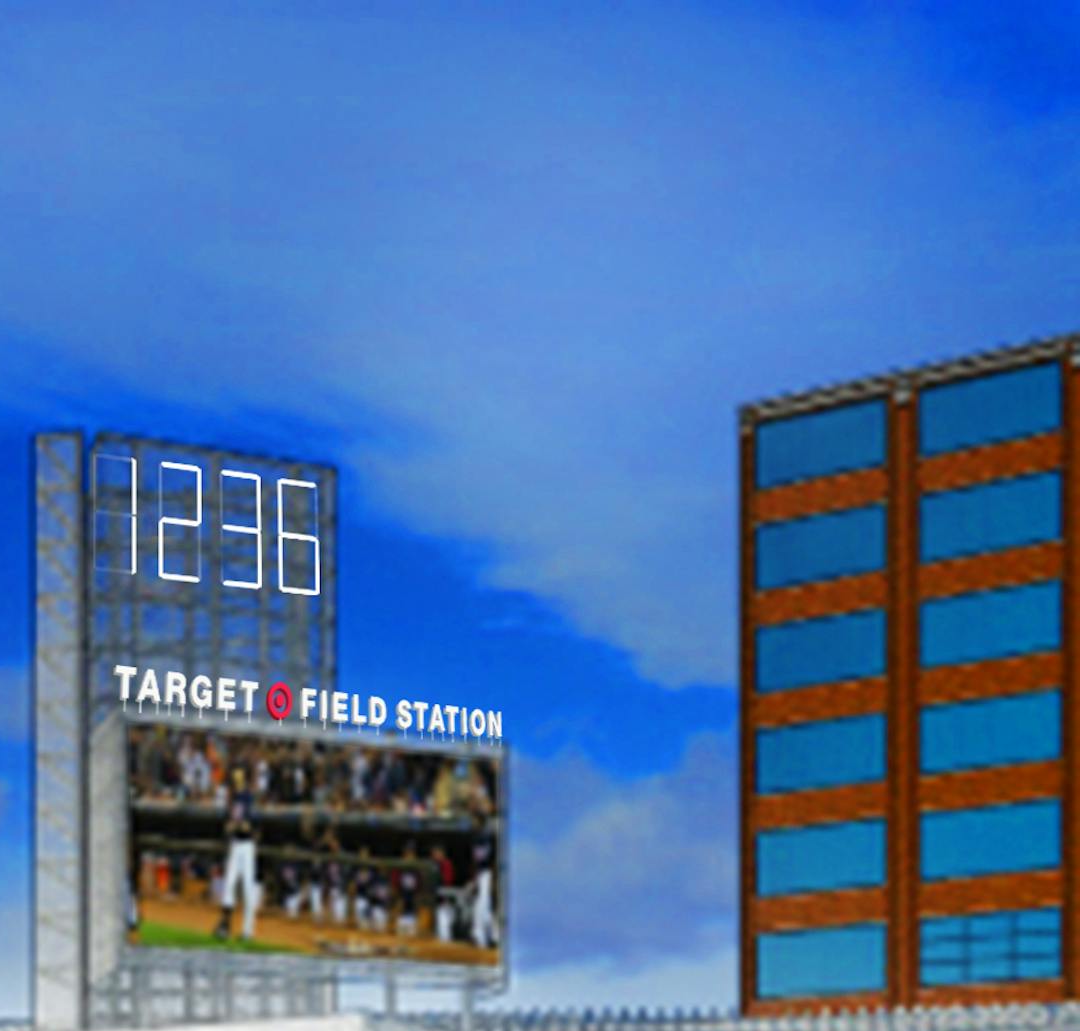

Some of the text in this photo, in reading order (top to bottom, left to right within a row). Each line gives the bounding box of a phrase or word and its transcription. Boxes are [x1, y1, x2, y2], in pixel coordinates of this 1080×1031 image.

[114, 665, 503, 738] TARGET FIELD STATION
